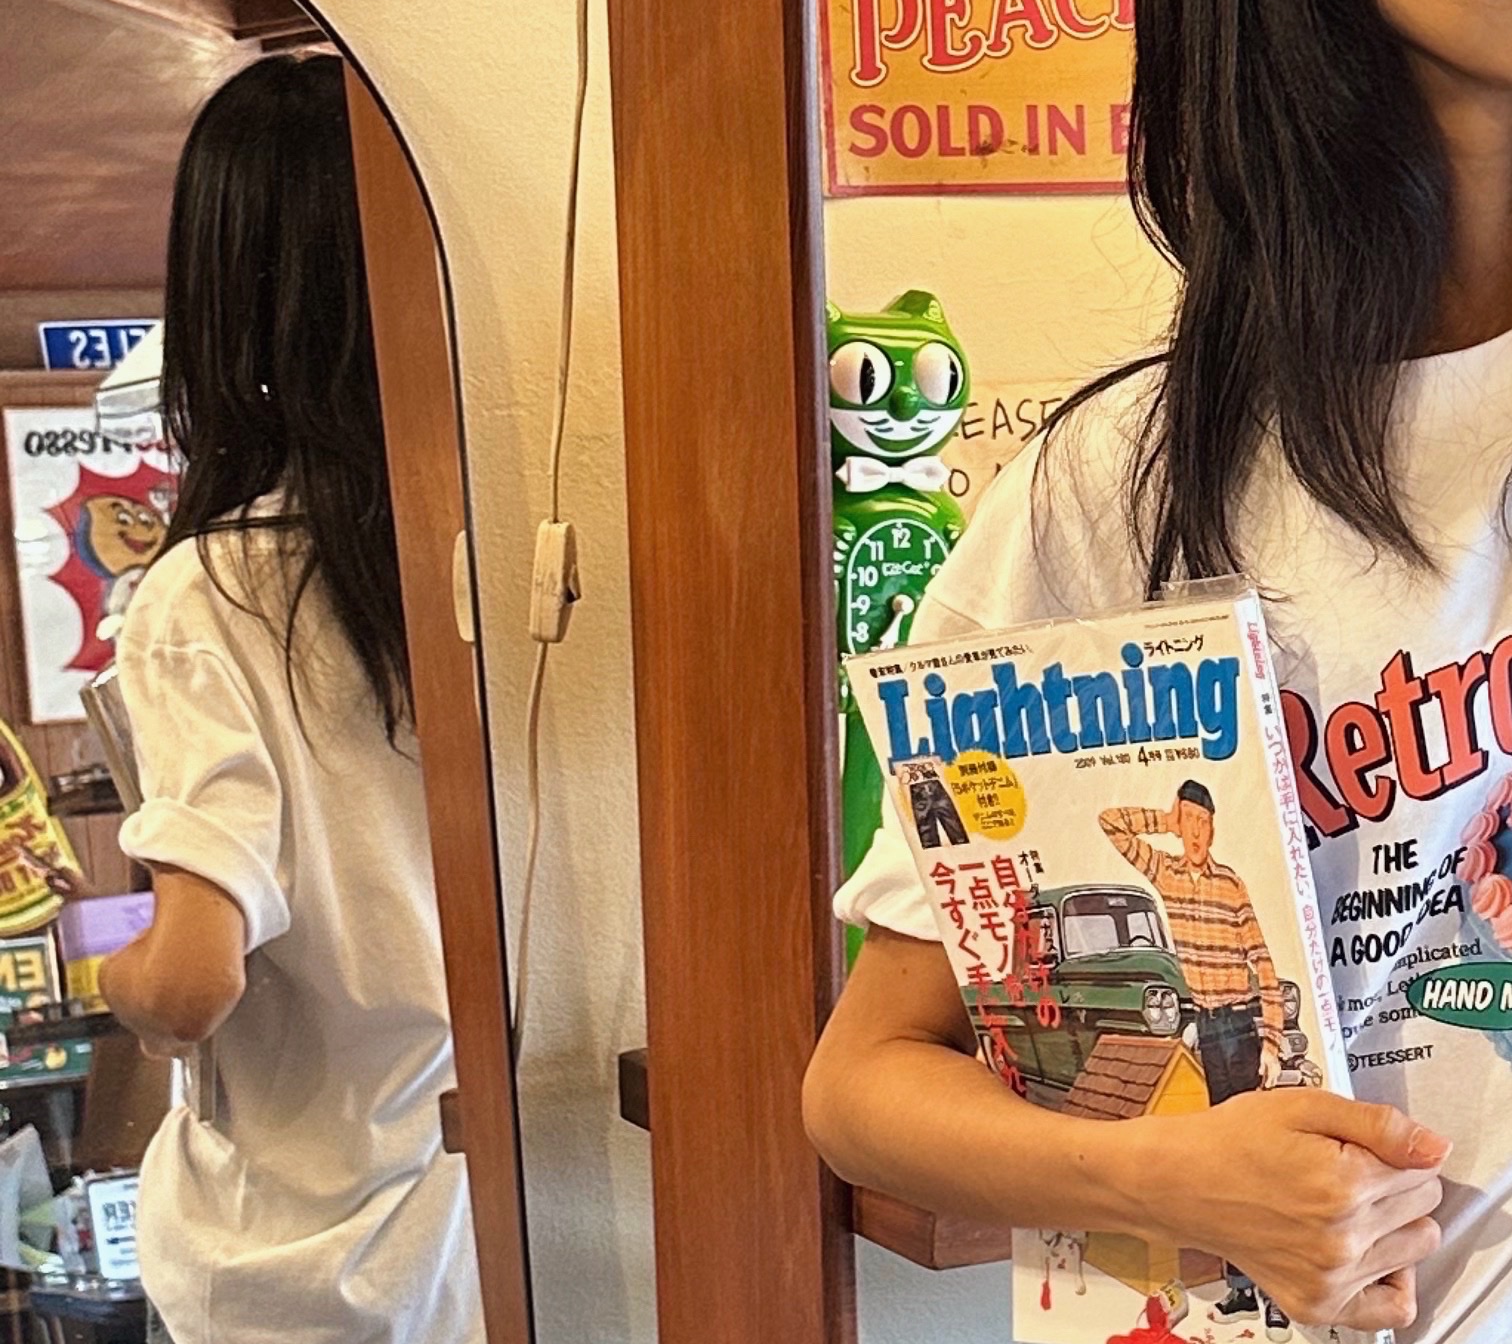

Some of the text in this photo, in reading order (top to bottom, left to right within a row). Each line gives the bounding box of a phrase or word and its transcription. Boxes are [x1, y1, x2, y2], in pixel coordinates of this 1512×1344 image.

[848, 103, 1005, 158] SOLD
[1023, 103, 1085, 156] IN
[891, 527, 912, 549] 12
[922, 539, 932, 560] 1
[870, 540, 885, 562] 11
[857, 565, 879, 587] 10
[856, 594, 871, 616] 9
[855, 621, 870, 644] 8
[1143, 633, 1205, 657] ライトニング
[877, 641, 1240, 776] Lightning
[1372, 838, 1419, 875] THE
[1437, 845, 1468, 881] OF
[1330, 936, 1347, 968] A
[1351, 921, 1414, 966] GOOD
[1421, 978, 1495, 1012] HAND
